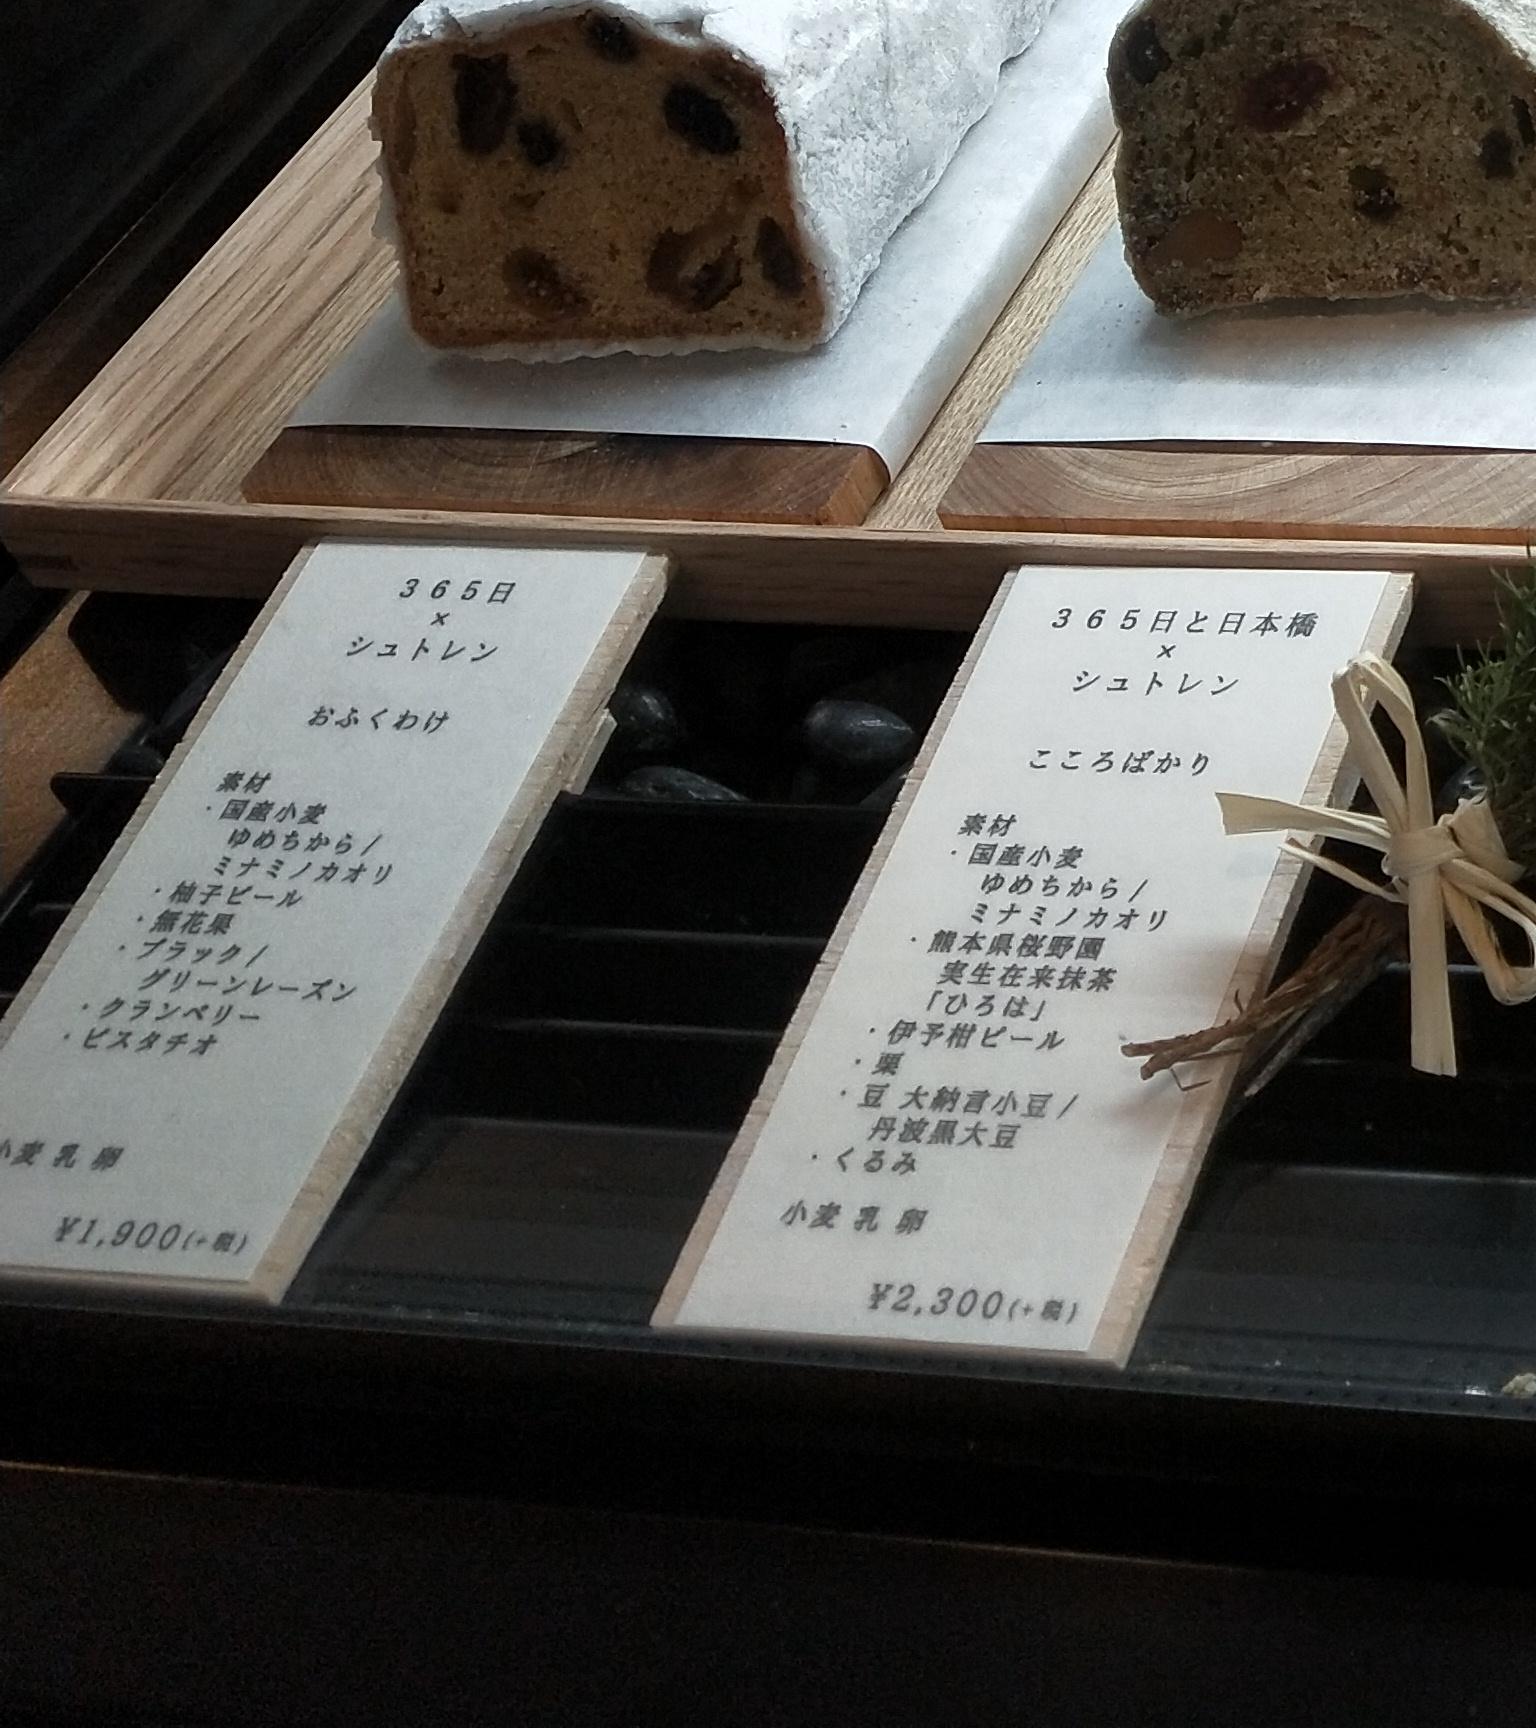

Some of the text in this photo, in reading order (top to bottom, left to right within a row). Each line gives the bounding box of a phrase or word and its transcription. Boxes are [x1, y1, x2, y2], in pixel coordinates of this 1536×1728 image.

[399, 577, 517, 605] 365日
[1051, 608, 1318, 638] 365日と日本橋
[346, 637, 499, 663] シュトレン
[1072, 670, 1239, 696] シュトレン
[308, 705, 450, 734] おふくわけ
[1028, 749, 1210, 776] こころばかり
[216, 770, 271, 794] 素材
[958, 813, 1017, 838] 素材
[214, 856, 392, 885] ミナミノカオリ
[970, 902, 1169, 931] ミナミノカオリ
[137, 969, 357, 1002] グリーンレーズン
[936, 959, 1117, 993] 実生在来抹茶
[867, 1116, 1021, 1149] 丹波黒大豆
[780, 1199, 842, 1229] 小麦
